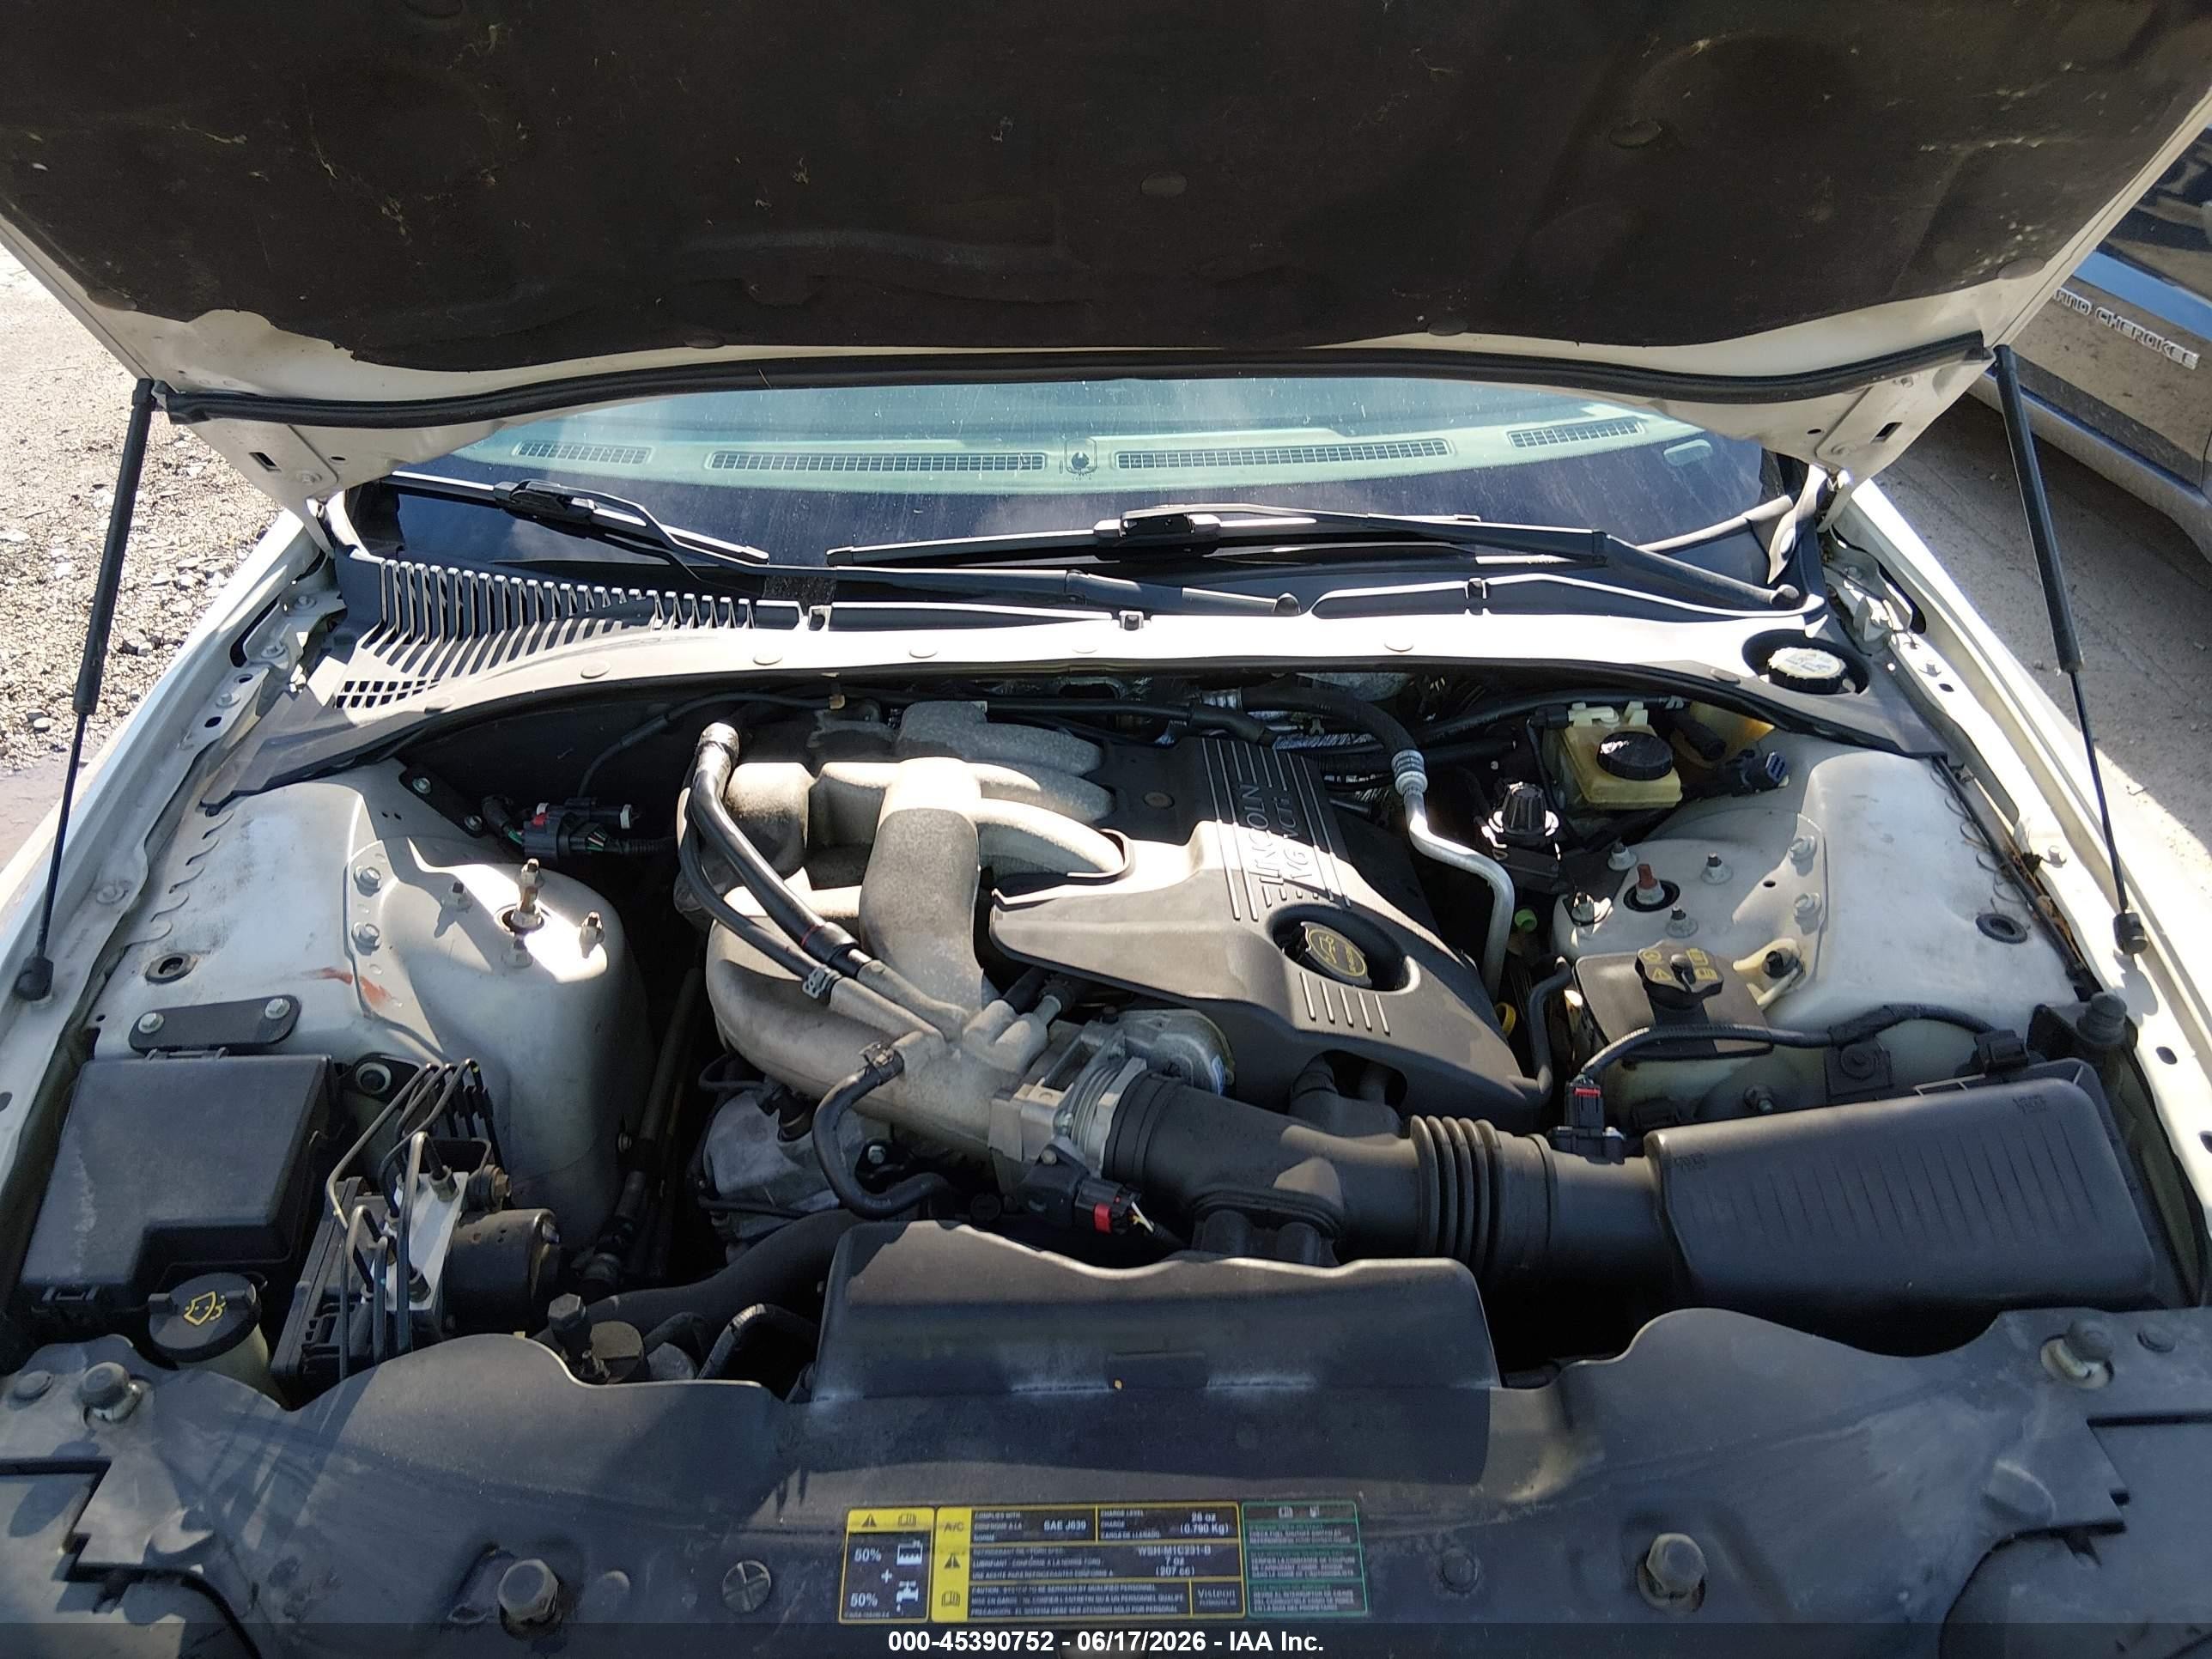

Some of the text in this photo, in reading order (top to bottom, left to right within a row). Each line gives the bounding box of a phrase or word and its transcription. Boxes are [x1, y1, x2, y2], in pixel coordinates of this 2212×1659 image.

[2095, 306, 2200, 370] CHEROKEE
[1239, 783, 1285, 885] LINCOLN
[944, 1522, 964, 1533] A/C
[854, 1547, 882, 1563] 50%
[850, 1591, 878, 1607] 50%
[1197, 1588, 1237, 1599] Visteon
